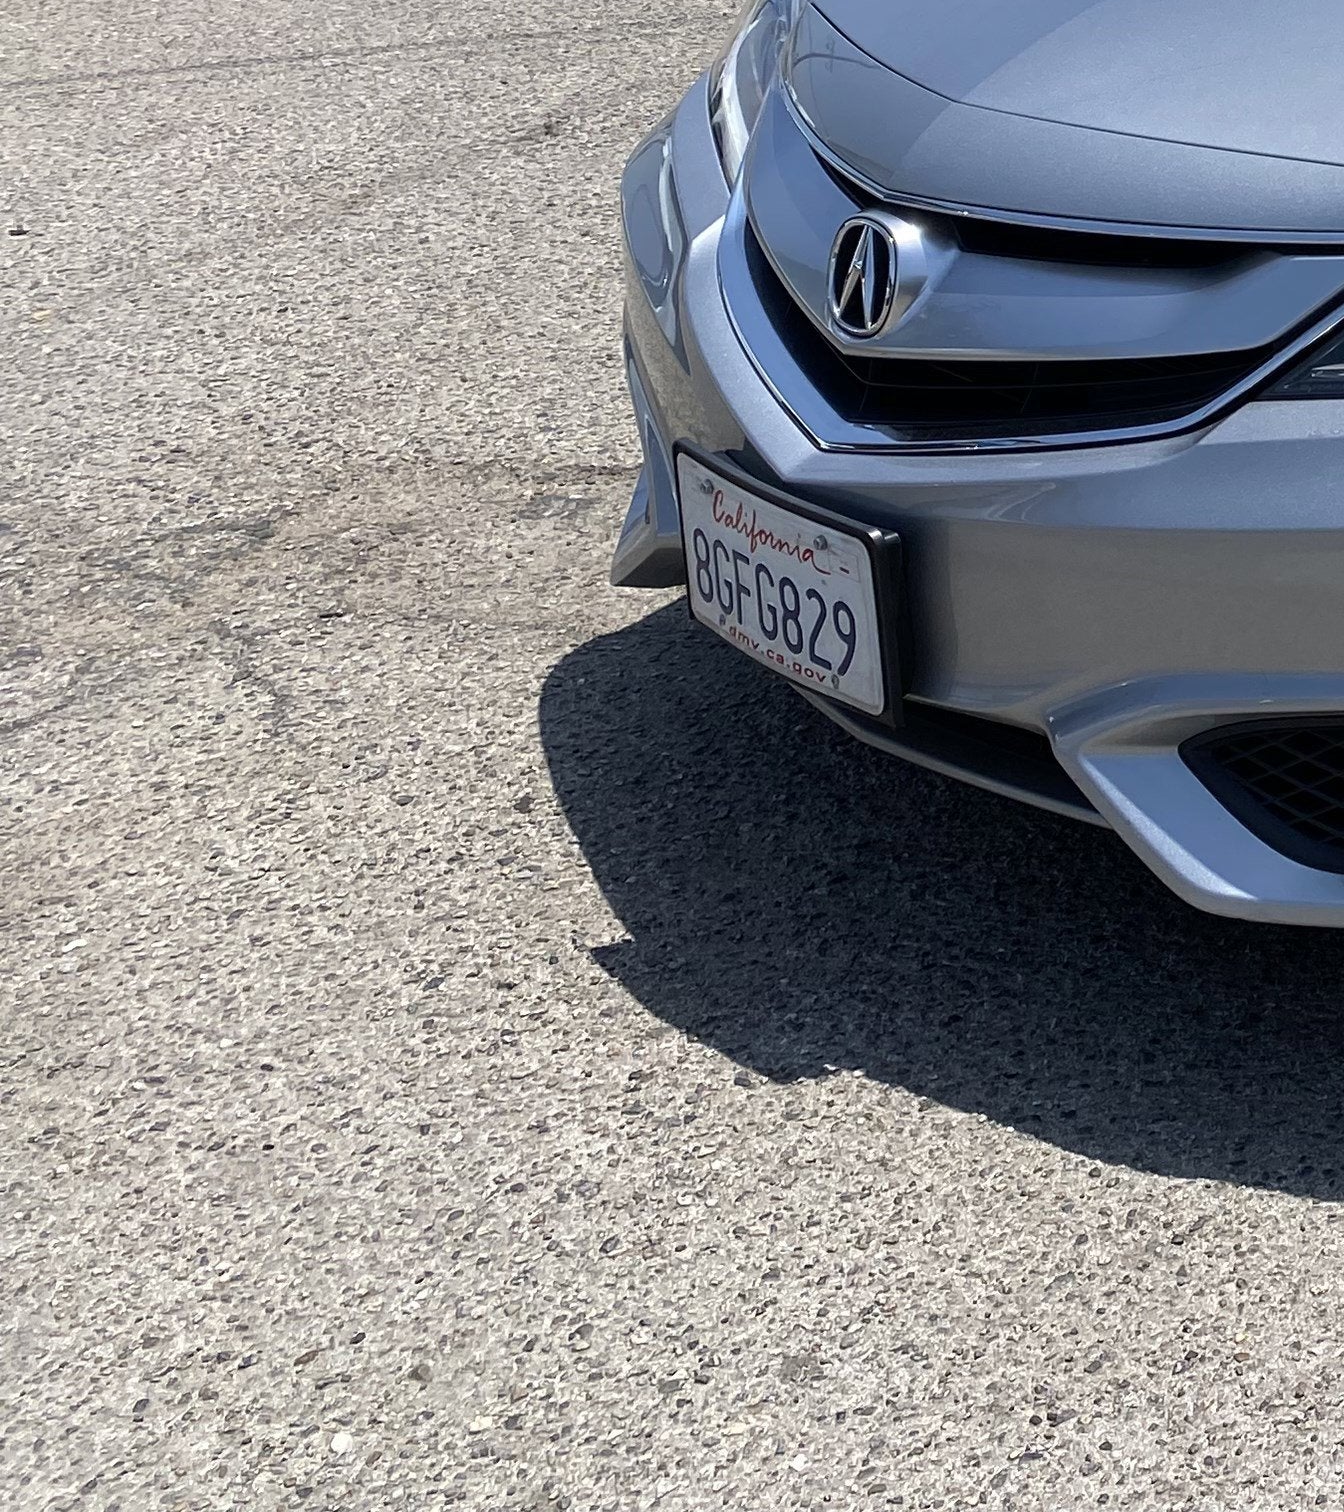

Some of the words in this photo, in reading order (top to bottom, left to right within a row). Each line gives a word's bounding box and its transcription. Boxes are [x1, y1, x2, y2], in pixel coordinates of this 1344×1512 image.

[712, 489, 832, 576] California
[693, 528, 857, 677] 8GFG829
[728, 625, 827, 684] dmv.ca.gov
